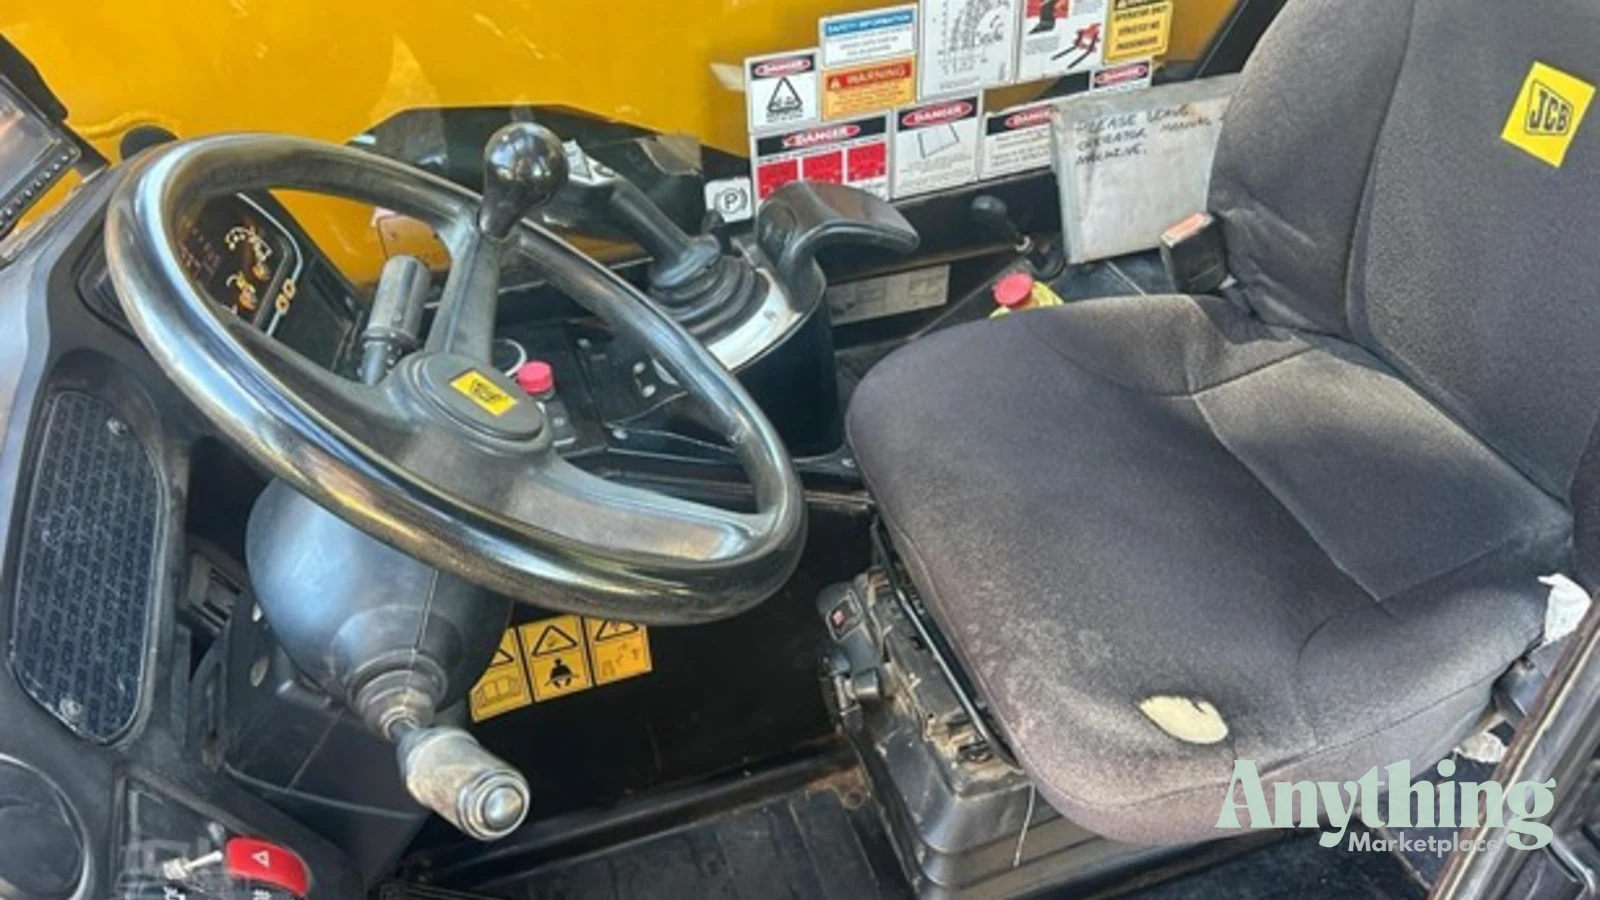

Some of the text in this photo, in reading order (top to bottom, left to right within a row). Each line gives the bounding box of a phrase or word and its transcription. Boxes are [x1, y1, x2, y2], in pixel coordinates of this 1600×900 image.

[763, 59, 804, 75] DANGER
[846, 65, 906, 84] WARNING
[914, 104, 962, 121] DANGER
[1529, 89, 1569, 132] JCB
[796, 126, 846, 145] DANGER
